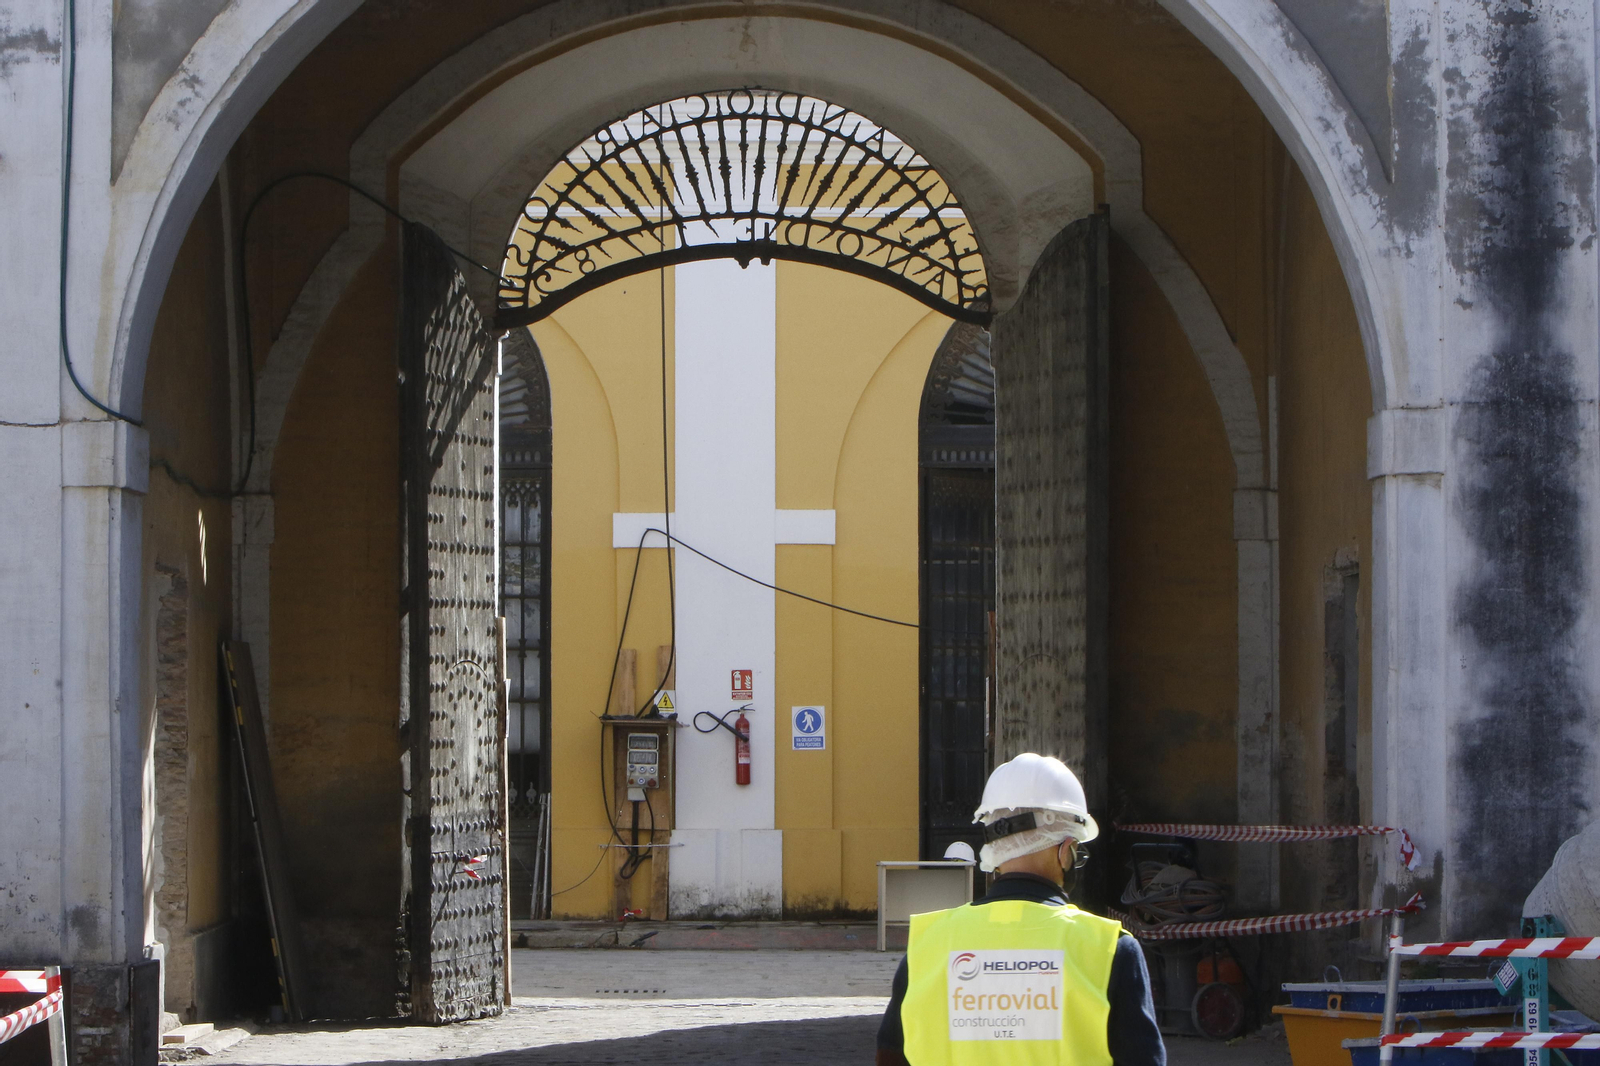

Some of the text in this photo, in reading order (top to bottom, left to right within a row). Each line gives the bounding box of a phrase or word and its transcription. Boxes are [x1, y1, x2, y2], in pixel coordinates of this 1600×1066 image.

[983, 960, 1059, 971] HELIOPOL
[952, 986, 1059, 1011] ferrovial
[1528, 1002, 1538, 1015] 63
[952, 1014, 1026, 1028] construcción
[1528, 1018, 1538, 1030] 19
[993, 1030, 1017, 1038] U.T.E.
